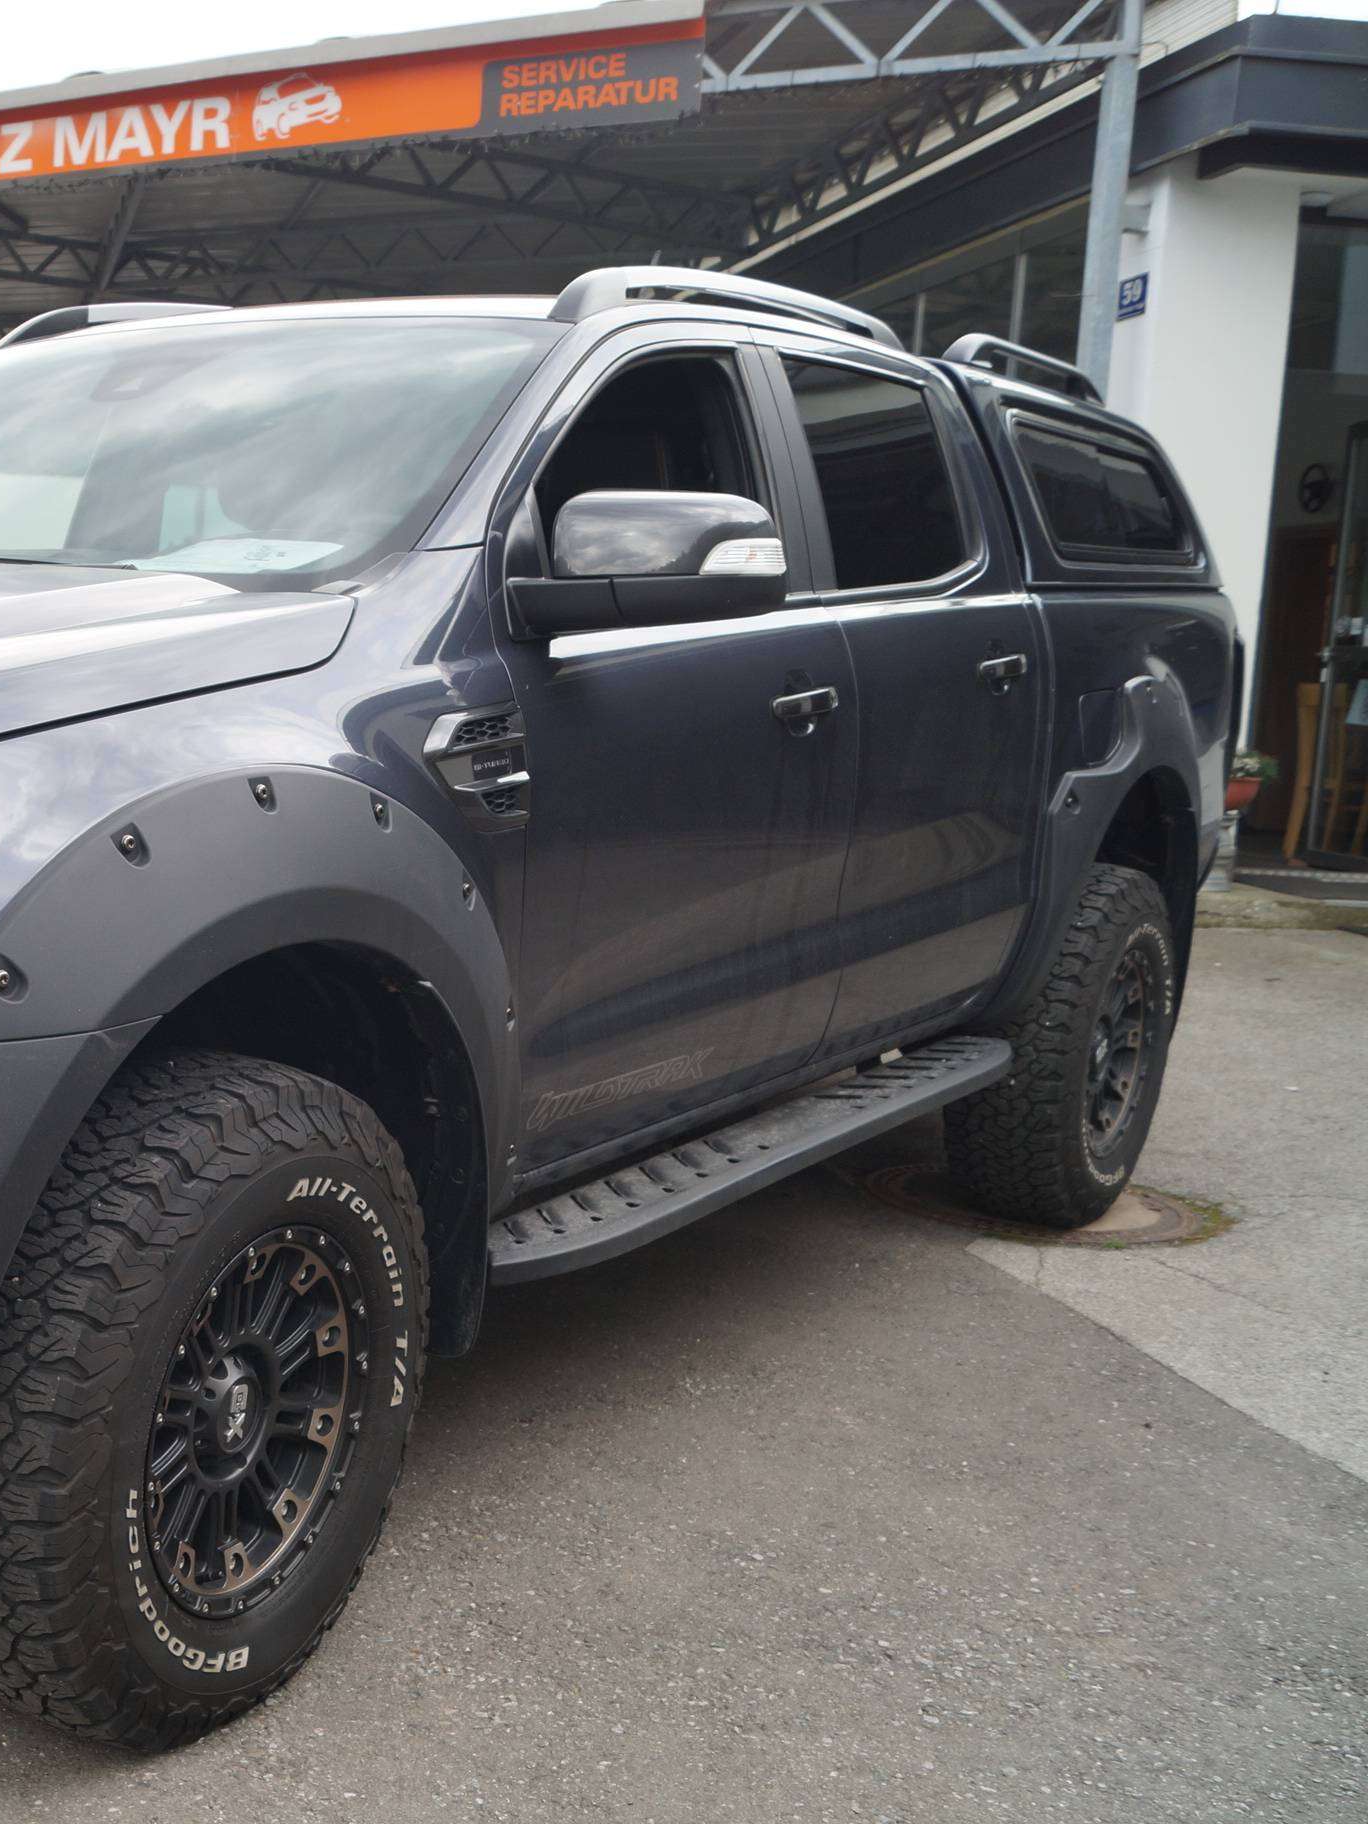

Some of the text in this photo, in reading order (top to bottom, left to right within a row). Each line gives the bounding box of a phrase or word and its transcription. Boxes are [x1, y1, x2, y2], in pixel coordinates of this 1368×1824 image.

[499, 76, 679, 118] REPARATUR
[501, 53, 627, 89] SERVICE
[53, 96, 231, 168] MAYR
[1123, 279, 1143, 305] 59
[287, 1177, 404, 1307] All-Terrain
[126, 1489, 249, 1673] BFGoodrich
